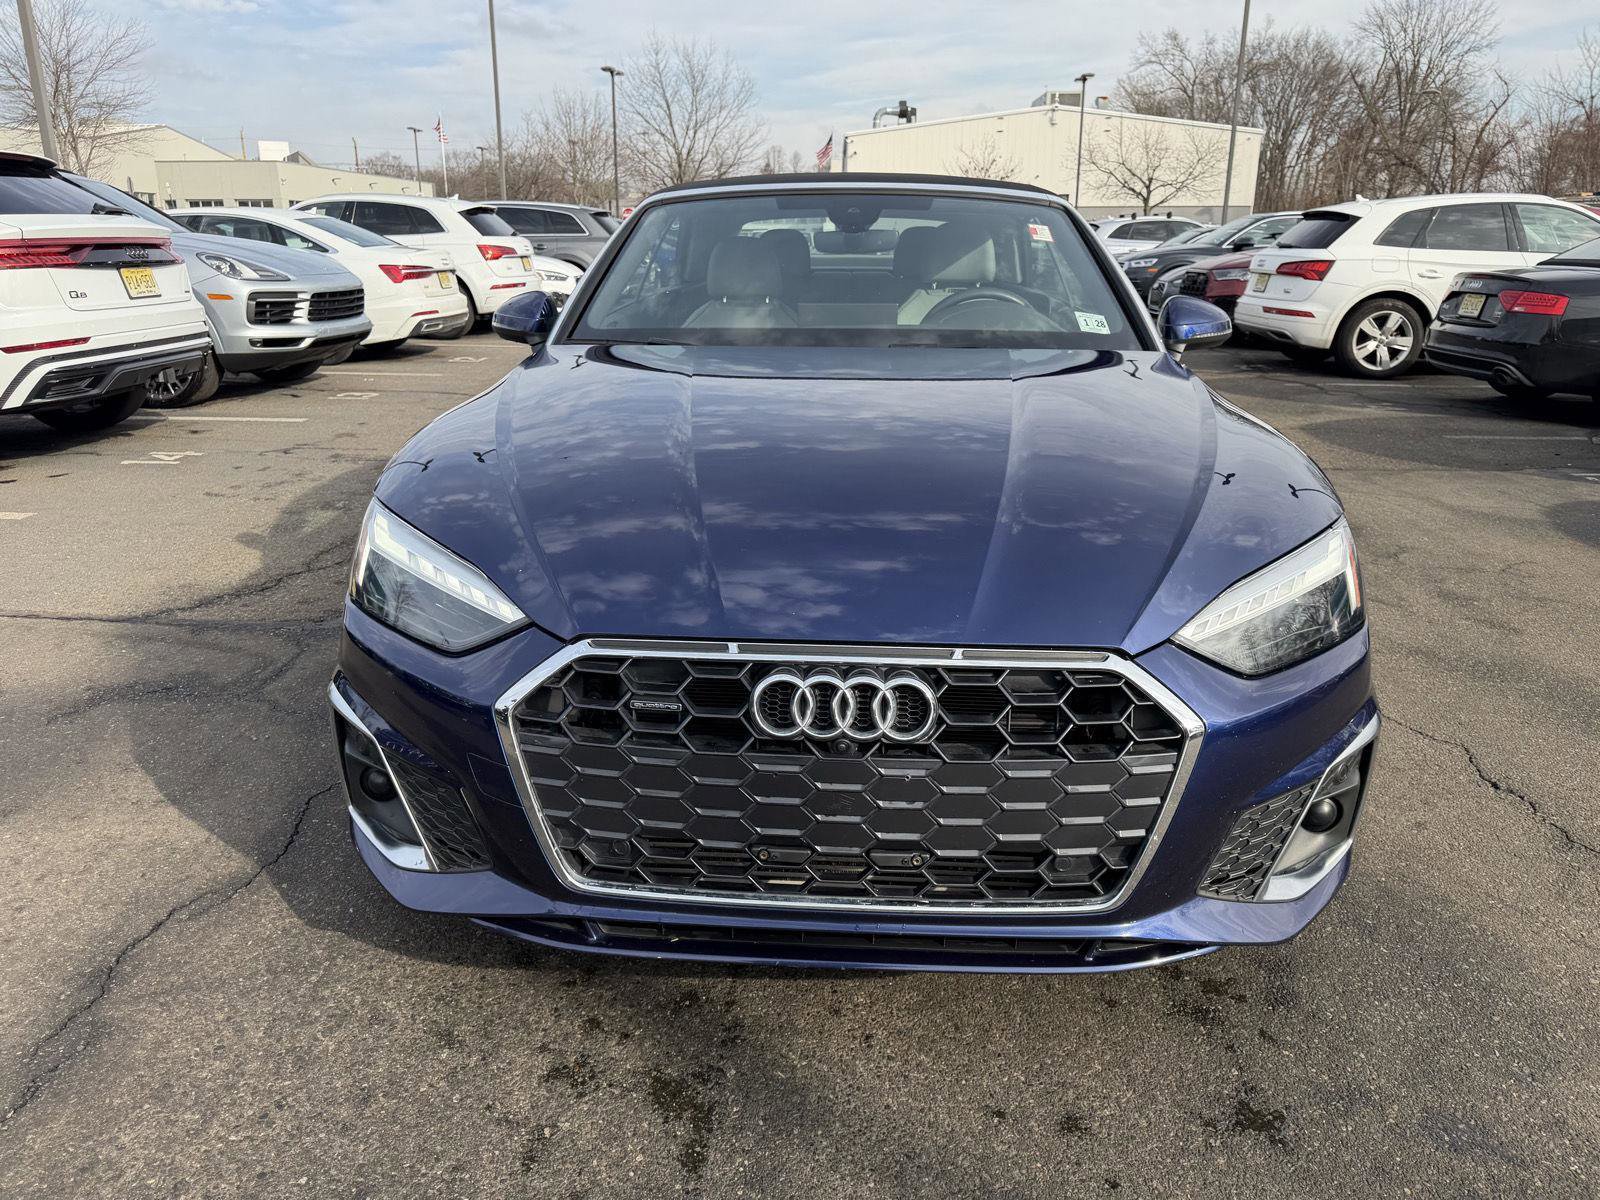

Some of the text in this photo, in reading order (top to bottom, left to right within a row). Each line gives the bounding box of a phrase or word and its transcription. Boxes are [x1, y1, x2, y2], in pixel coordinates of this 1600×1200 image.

[69, 290, 88, 299] Q8
[1094, 319, 1106, 328] 28
[633, 702, 678, 710] quattro
